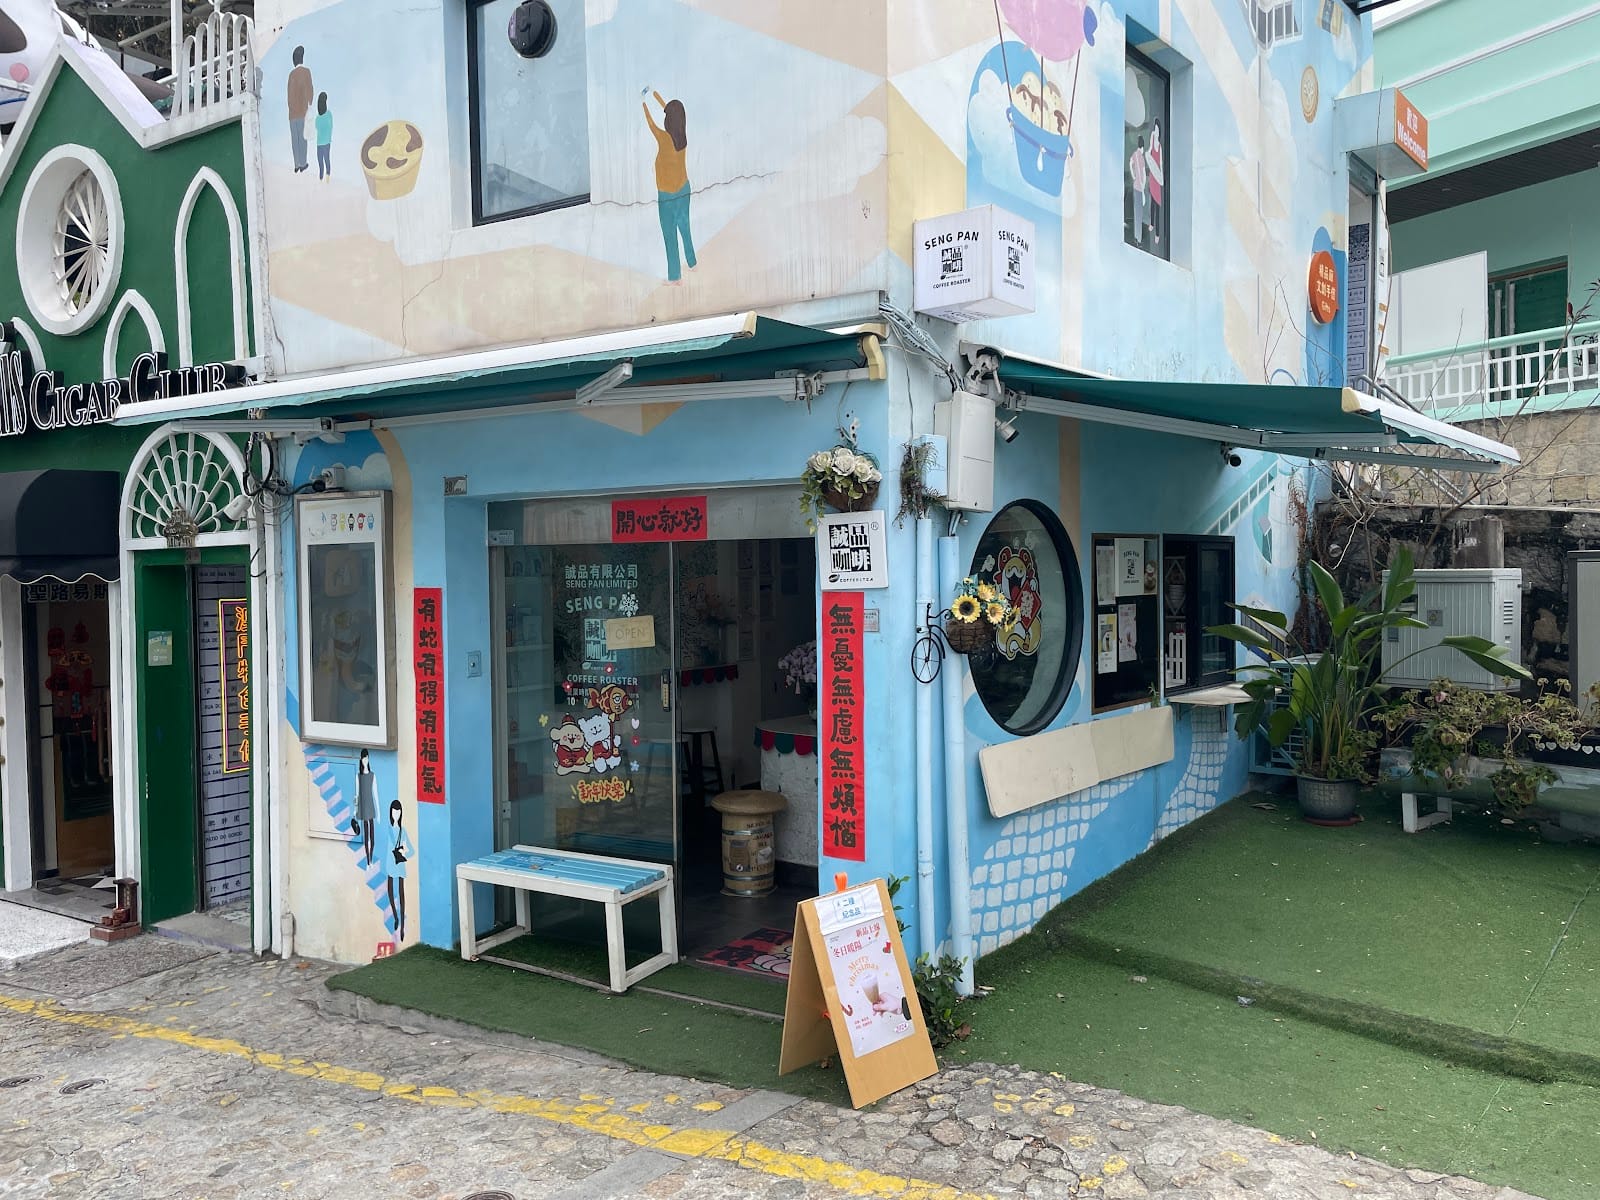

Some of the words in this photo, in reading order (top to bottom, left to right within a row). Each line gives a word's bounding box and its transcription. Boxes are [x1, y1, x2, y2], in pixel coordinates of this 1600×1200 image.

[1397, 119, 1427, 163] Welcome
[924, 233, 953, 251] SENG
[957, 231, 980, 242] PAN
[998, 230, 1015, 243] SENG
[1016, 236, 1030, 253] PAN
[30, 370, 122, 430] CIGAR
[615, 505, 703, 535] 開心就好
[830, 547, 871, 573] 咖啡
[565, 564, 638, 580] 誠品有限公司
[565, 580, 587, 589] SENG
[588, 580, 605, 588] PAN
[606, 579, 638, 588] LIMITED
[565, 596, 603, 614] SENG
[615, 627, 646, 641] OPEN
[567, 674, 597, 685] COFFEE
[600, 675, 638, 686] ROASTER
[416, 598, 442, 794] 有蛇有得有福氣
[829, 603, 858, 848] 無憂無慮無煩惱
